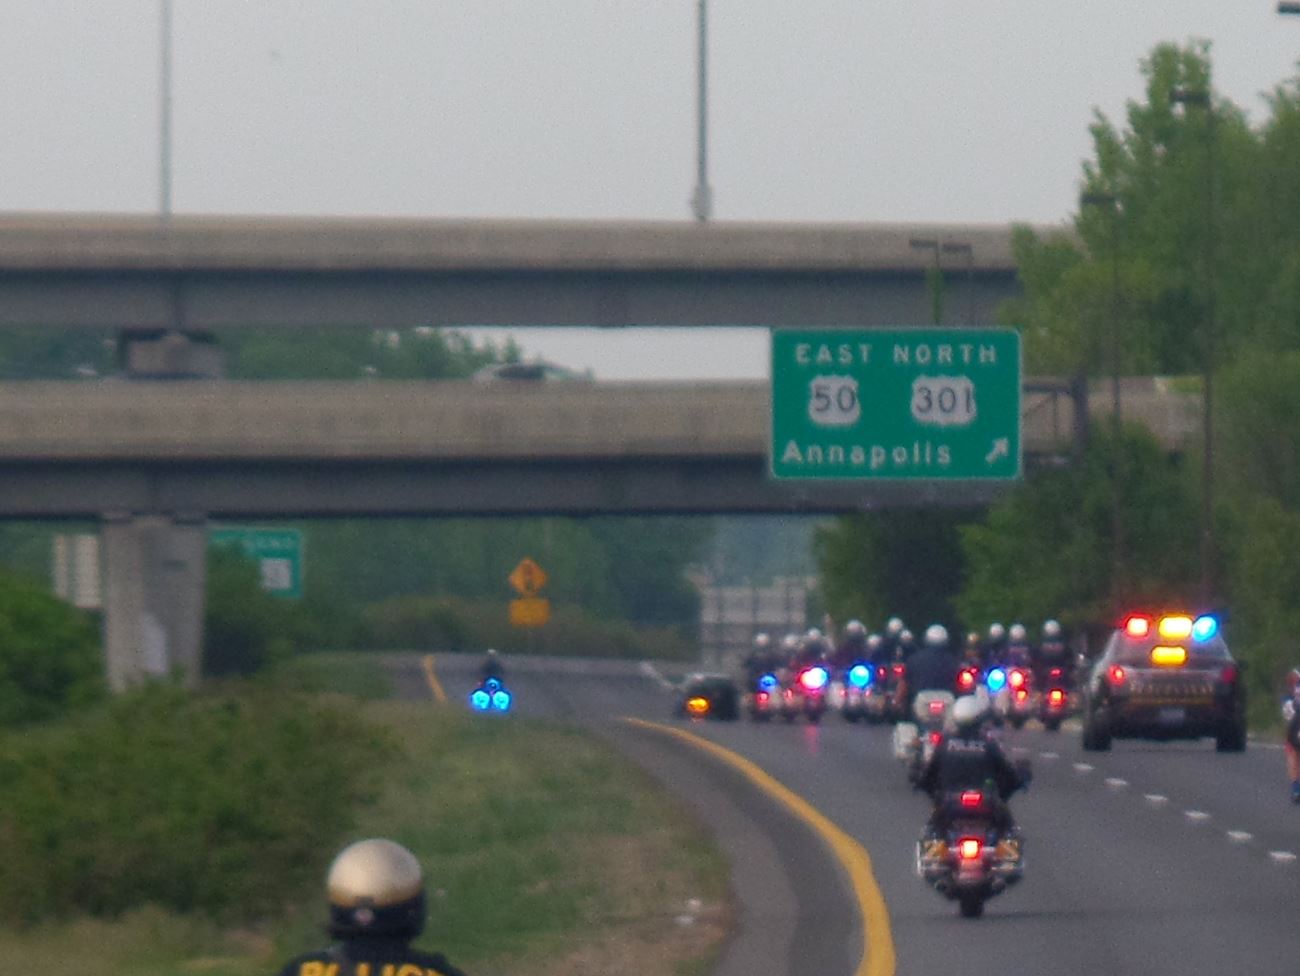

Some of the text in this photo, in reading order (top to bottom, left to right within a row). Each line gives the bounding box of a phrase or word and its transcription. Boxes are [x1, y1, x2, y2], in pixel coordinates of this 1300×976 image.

[795, 344, 996, 364] EAST NORTH
[814, 386, 971, 414] 50 301
[782, 440, 952, 469] Annapolis
